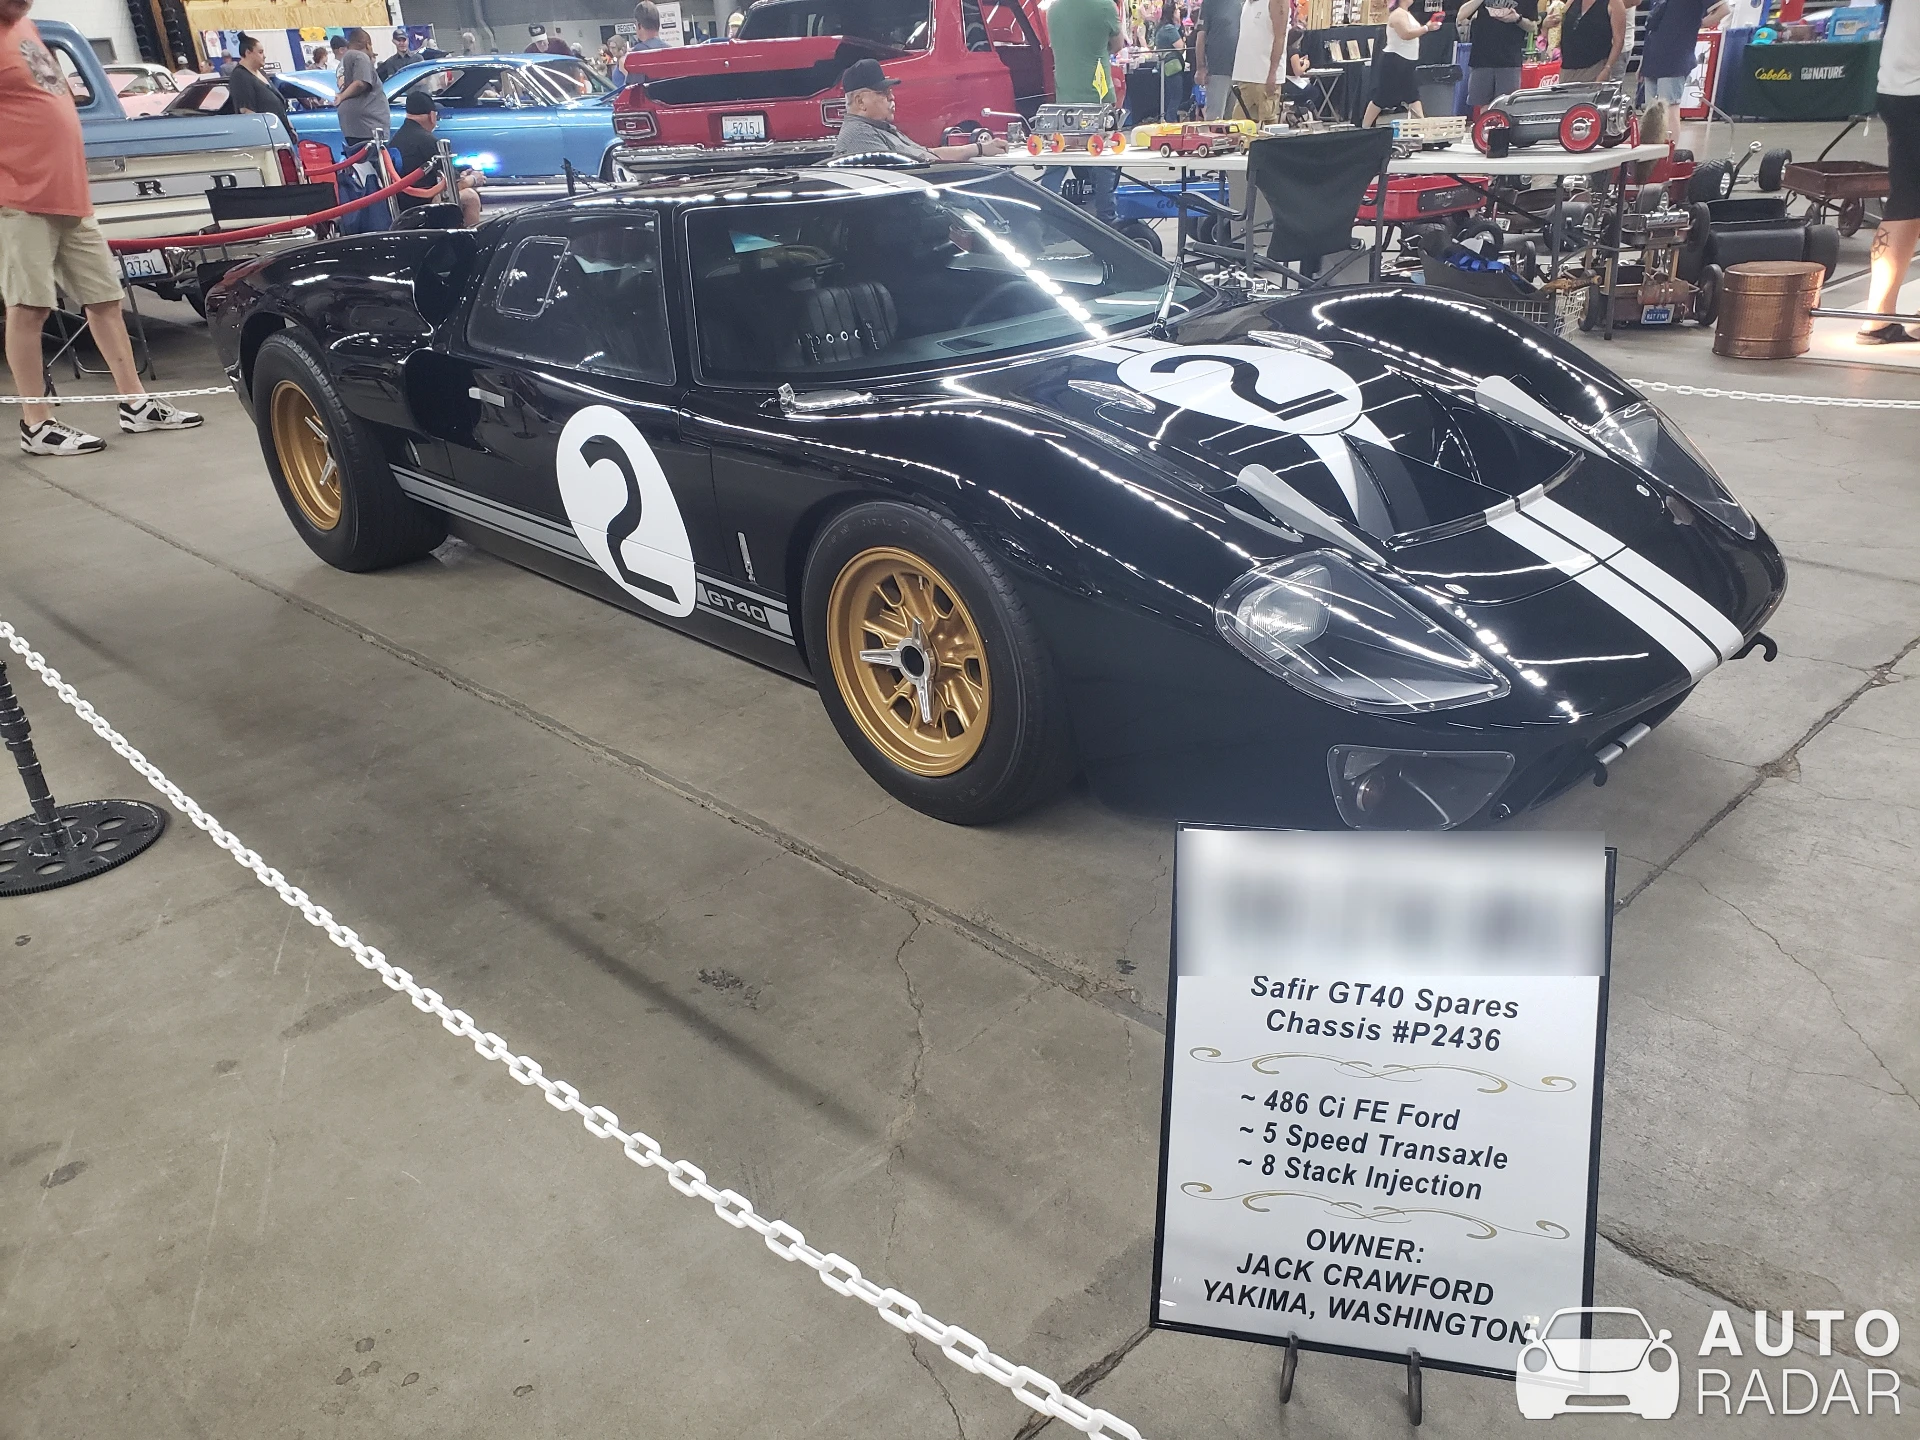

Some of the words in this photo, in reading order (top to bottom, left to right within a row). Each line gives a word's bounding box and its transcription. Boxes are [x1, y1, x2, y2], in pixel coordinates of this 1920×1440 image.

[732, 121, 761, 135] 5215J
[1063, 109, 1075, 126] 6
[1150, 354, 1350, 422] 2
[579, 434, 682, 606] 2
[1250, 975, 1319, 1000] Safir
[1328, 981, 1404, 1008] GT40
[1414, 988, 1519, 1018] Spares
[1266, 1009, 1381, 1041] Chassis
[1392, 1020, 1501, 1052] #P2436
[1264, 1090, 1310, 1115] 486
[1318, 1095, 1346, 1119] Ci
[1353, 1099, 1390, 1123] FE
[1396, 1103, 1461, 1130] Ford
[1263, 1122, 1278, 1143] 5
[1286, 1124, 1369, 1153] Speed
[1378, 1134, 1508, 1170] Transaxle
[1261, 1154, 1276, 1176] 8
[1284, 1156, 1357, 1186] Stack
[1365, 1165, 1482, 1200] Injection
[1306, 1228, 1424, 1264] OWNER:
[1236, 1253, 1313, 1283] JACK
[1323, 1264, 1494, 1306] CRAWFORD
[1203, 1279, 1316, 1320] YAKIMA,
[1328, 1296, 1531, 1345] WASHINGTON
